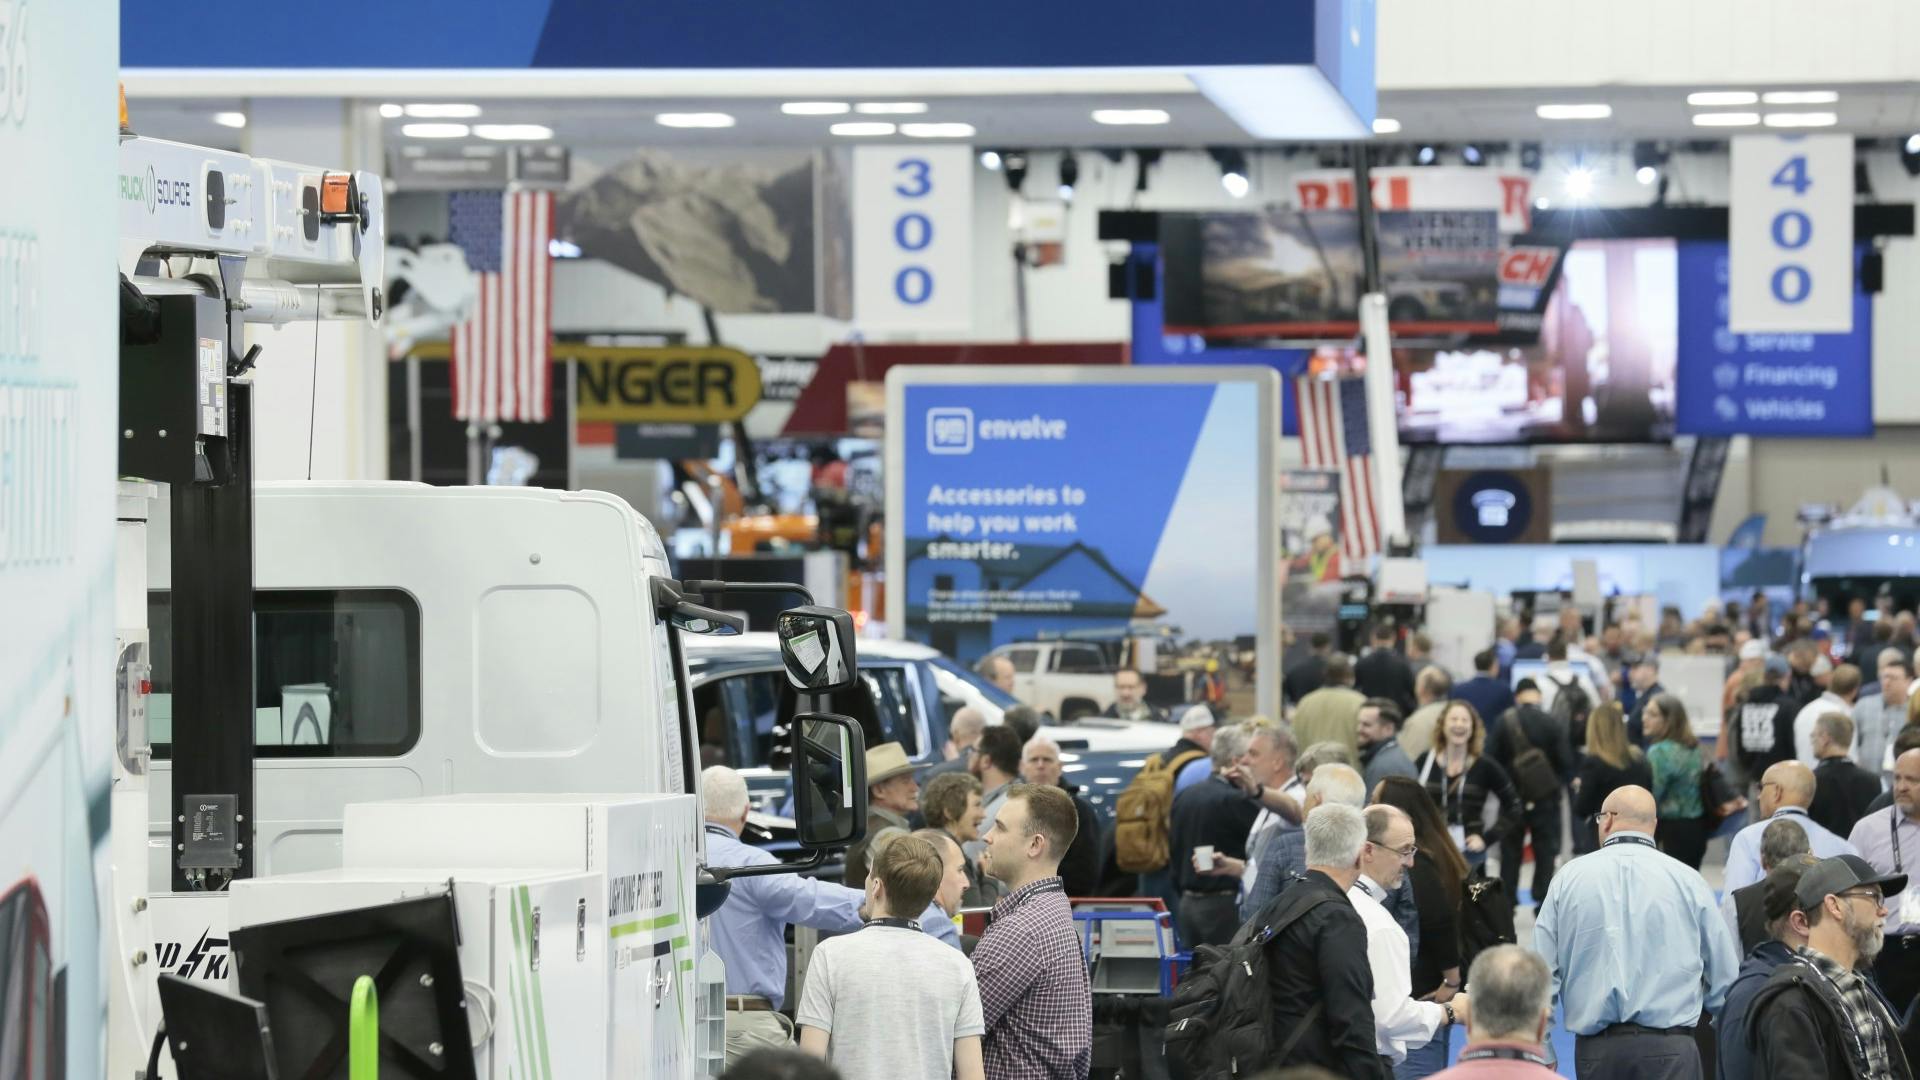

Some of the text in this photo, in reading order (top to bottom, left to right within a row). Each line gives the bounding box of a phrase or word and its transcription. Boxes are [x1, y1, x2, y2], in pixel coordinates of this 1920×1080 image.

[157, 179, 191, 207] SOURCE
[894, 158, 933, 305] 300
[1744, 363, 1838, 390] Financing
[1744, 398, 1826, 421] Vehicles
[979, 414, 1067, 440] envolve
[927, 484, 1086, 506] Accessories to
[927, 512, 1077, 536] help you work
[927, 540, 1020, 560] smarter.
